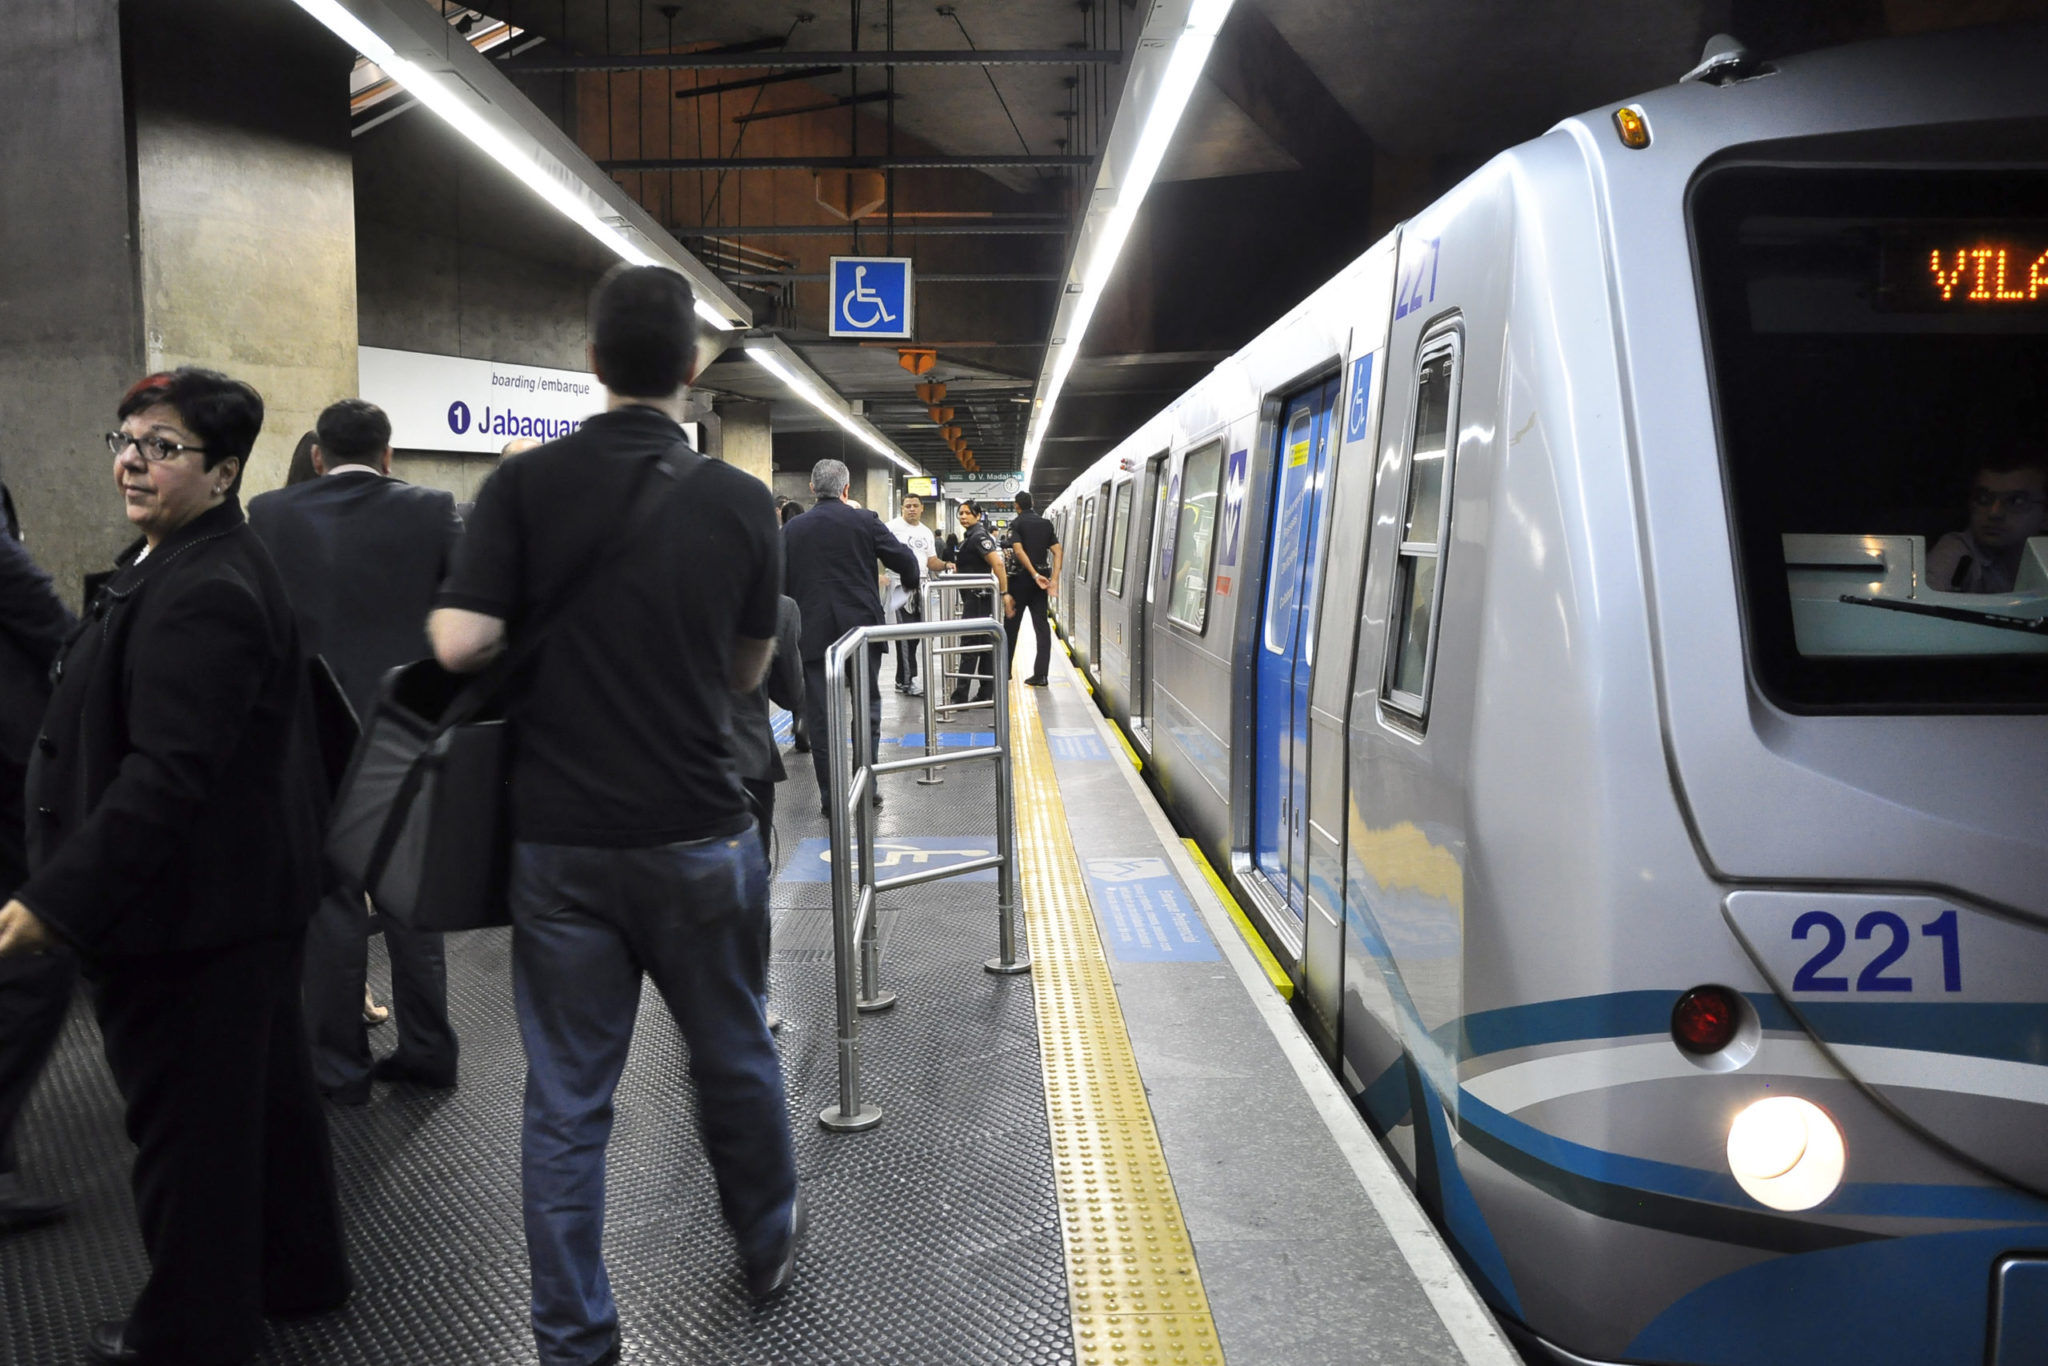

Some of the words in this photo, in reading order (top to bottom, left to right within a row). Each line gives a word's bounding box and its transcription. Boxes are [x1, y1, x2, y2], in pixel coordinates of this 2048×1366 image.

[492, 373, 536, 392] boarding
[478, 405, 584, 443] Jabaquar
[986, 472, 1022, 481] Madalna
[1791, 910, 1962, 992] 221
